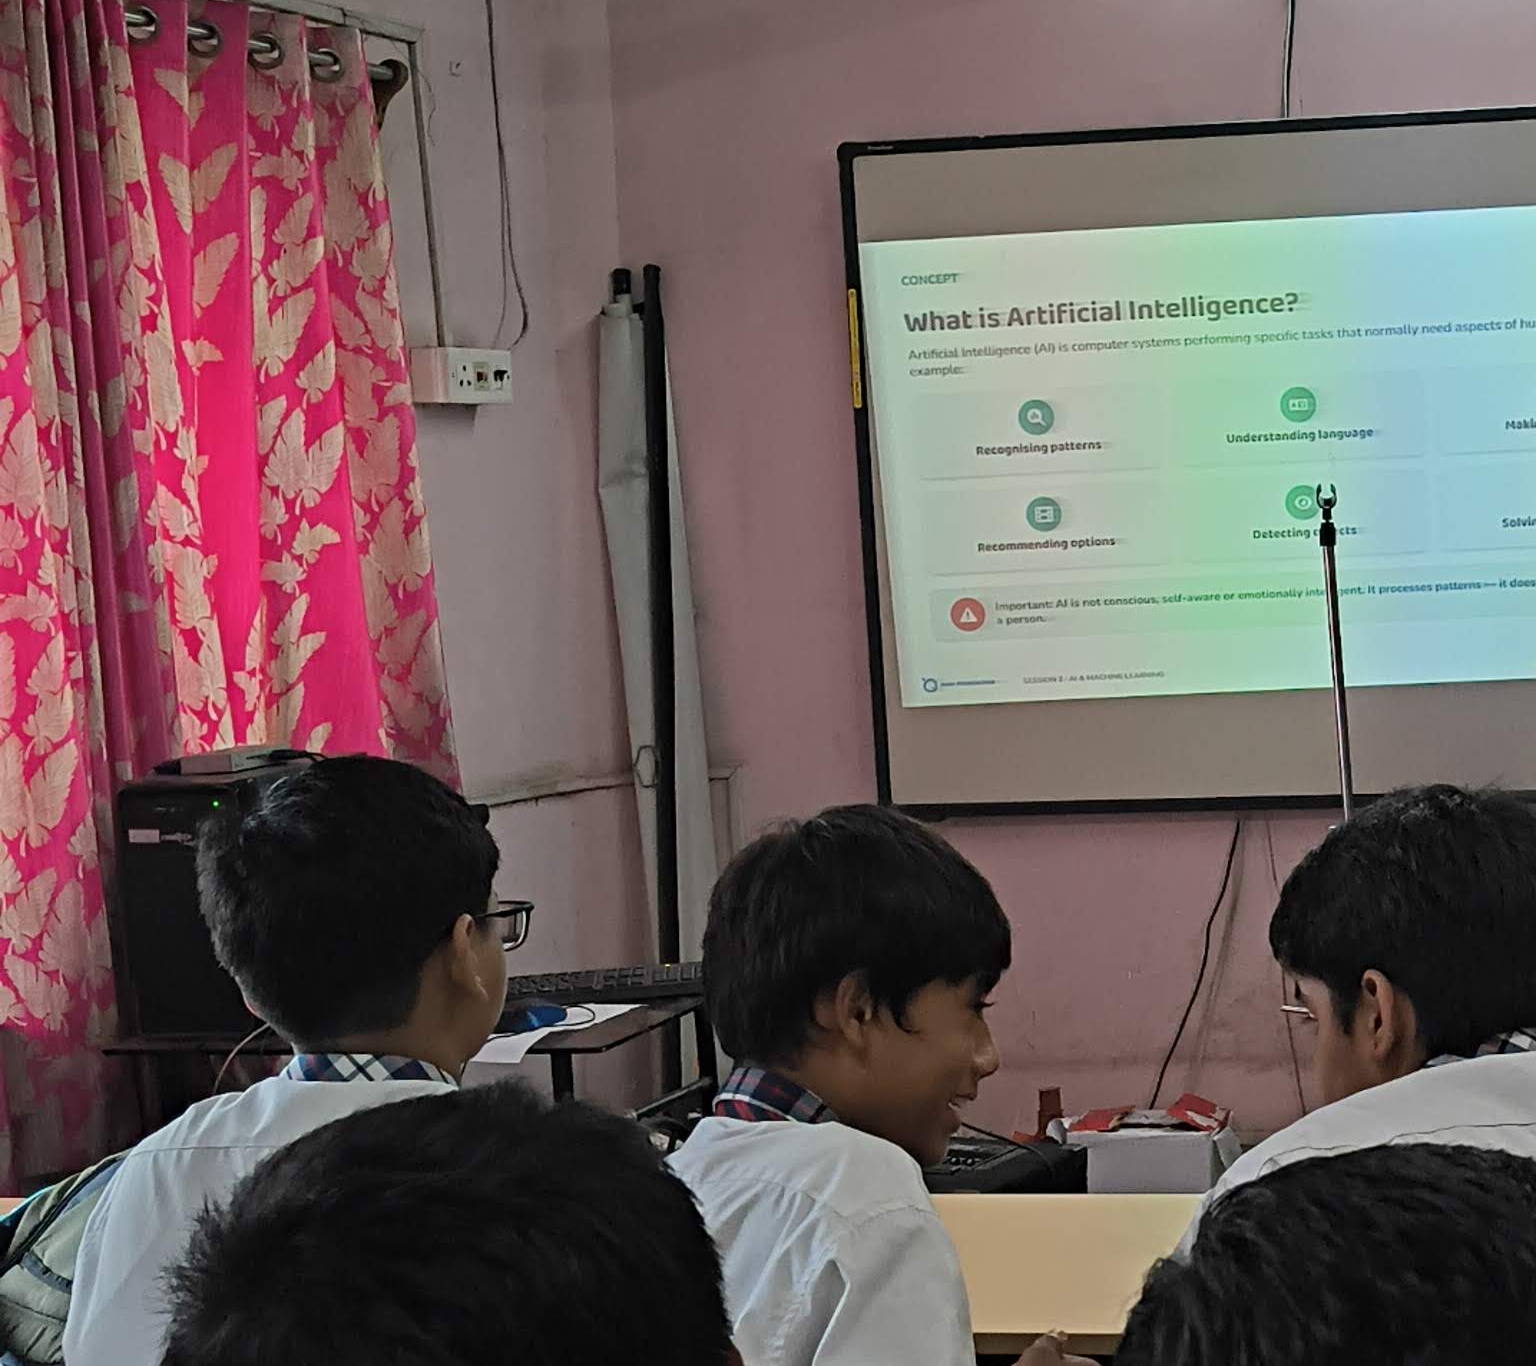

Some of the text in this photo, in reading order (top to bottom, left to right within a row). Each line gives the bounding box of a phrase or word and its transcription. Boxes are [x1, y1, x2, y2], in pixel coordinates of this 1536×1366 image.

[901, 273, 958, 286] CONCEPT
[904, 291, 1299, 332] What is Artificial Intelligence?
[908, 347, 960, 361] Artificial
[961, 342, 1032, 358] Intelligence
[1034, 342, 1056, 356] (AI)
[1058, 341, 1070, 353] is
[1071, 339, 1129, 355] computer
[1131, 335, 1181, 351] systems
[1184, 331, 1252, 348] performing
[1254, 328, 1300, 344] specific
[1302, 328, 1334, 341] tasks
[1337, 327, 1363, 339] that
[1365, 324, 1418, 339] normally
[1421, 321, 1452, 335] need
[1455, 319, 1502, 334] aspects
[1505, 318, 1518, 330] of
[909, 365, 963, 379] example:
[1226, 426, 1374, 444] Understanding language
[976, 439, 1102, 456] Recognising patterns
[1253, 527, 1311, 539] Detecting
[977, 535, 1116, 553] Recommending options
[995, 600, 1054, 614] Important:
[1056, 599, 1068, 608] AI
[1070, 598, 1080, 608] is
[1082, 598, 1101, 607] not
[1162, 592, 1220, 604] self-aware
[1223, 592, 1235, 601] or
[1238, 587, 1304, 600] emotionally
[1367, 585, 1376, 594] It
[1378, 582, 1433, 595] processes
[1435, 580, 1482, 592] patterns
[1499, 579, 1508, 588] it
[1510, 577, 1536, 587] does
